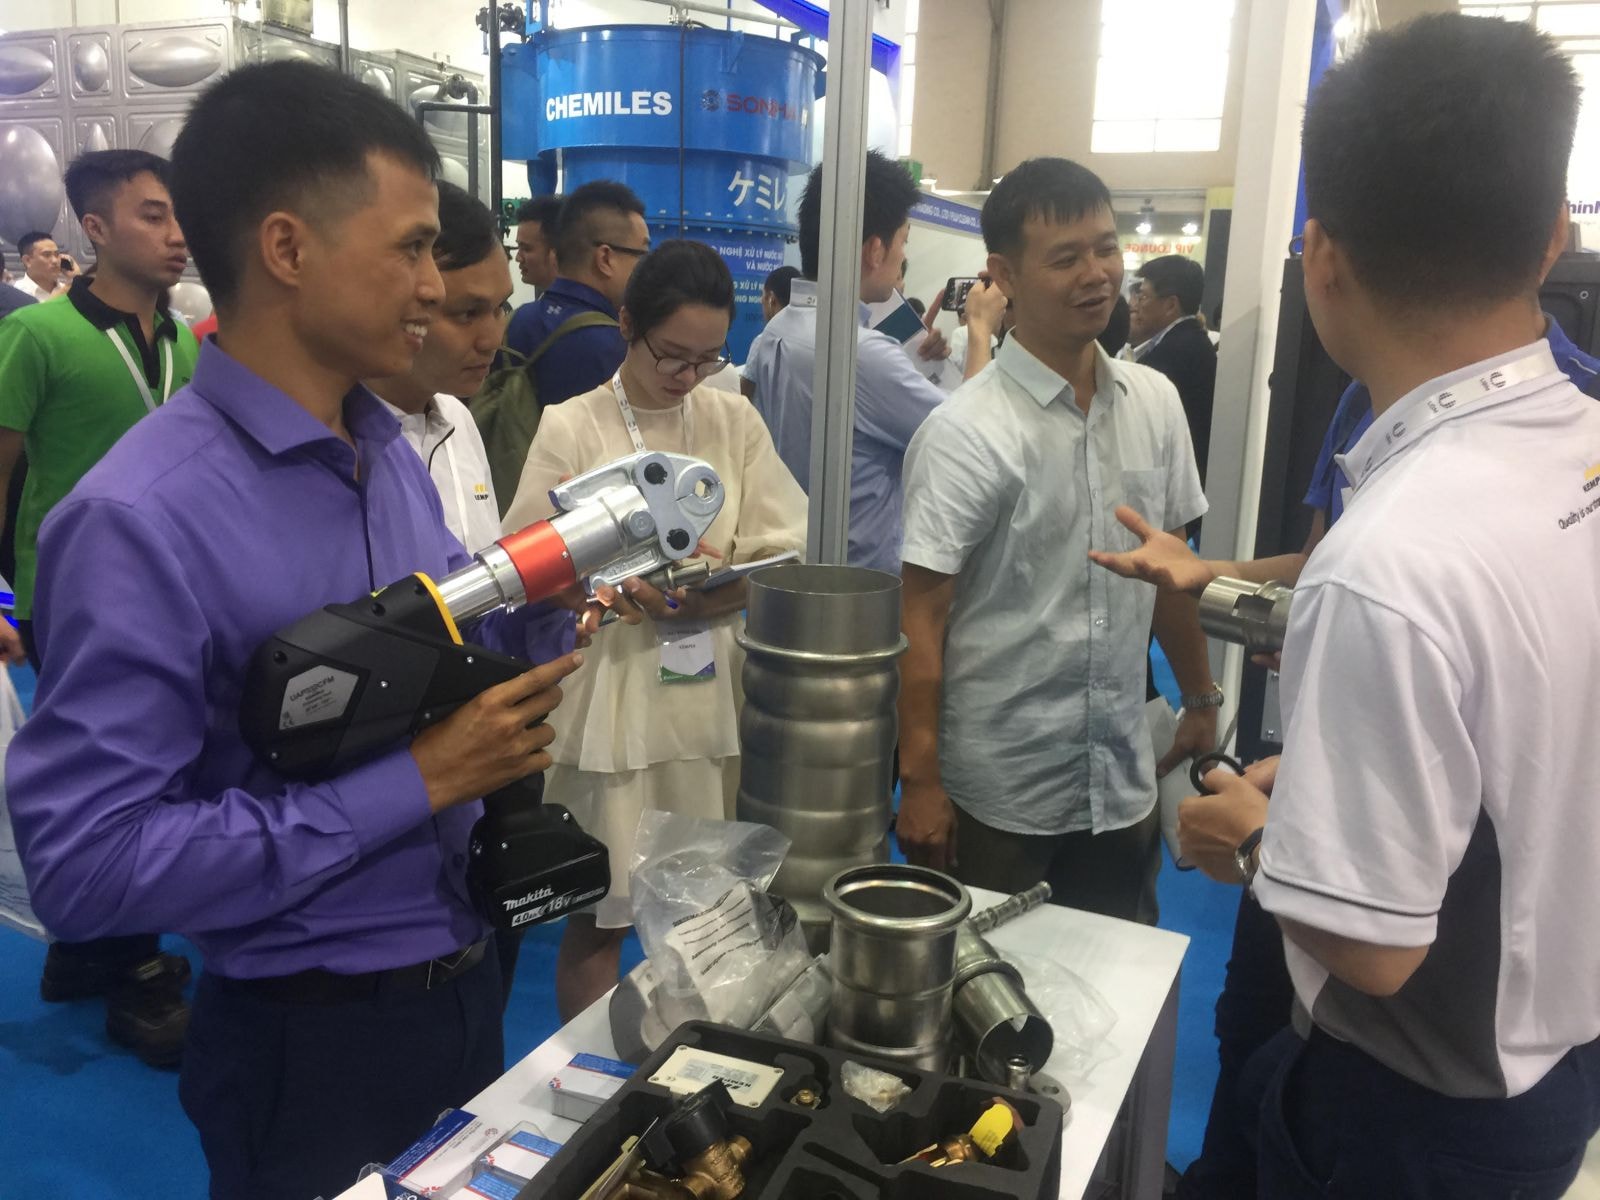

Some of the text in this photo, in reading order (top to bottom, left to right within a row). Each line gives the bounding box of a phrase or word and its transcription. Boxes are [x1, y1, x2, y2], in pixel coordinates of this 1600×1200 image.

[546, 91, 673, 122] CHEMILES
[1558, 512, 1581, 530] Quality
[502, 887, 555, 912] makita
